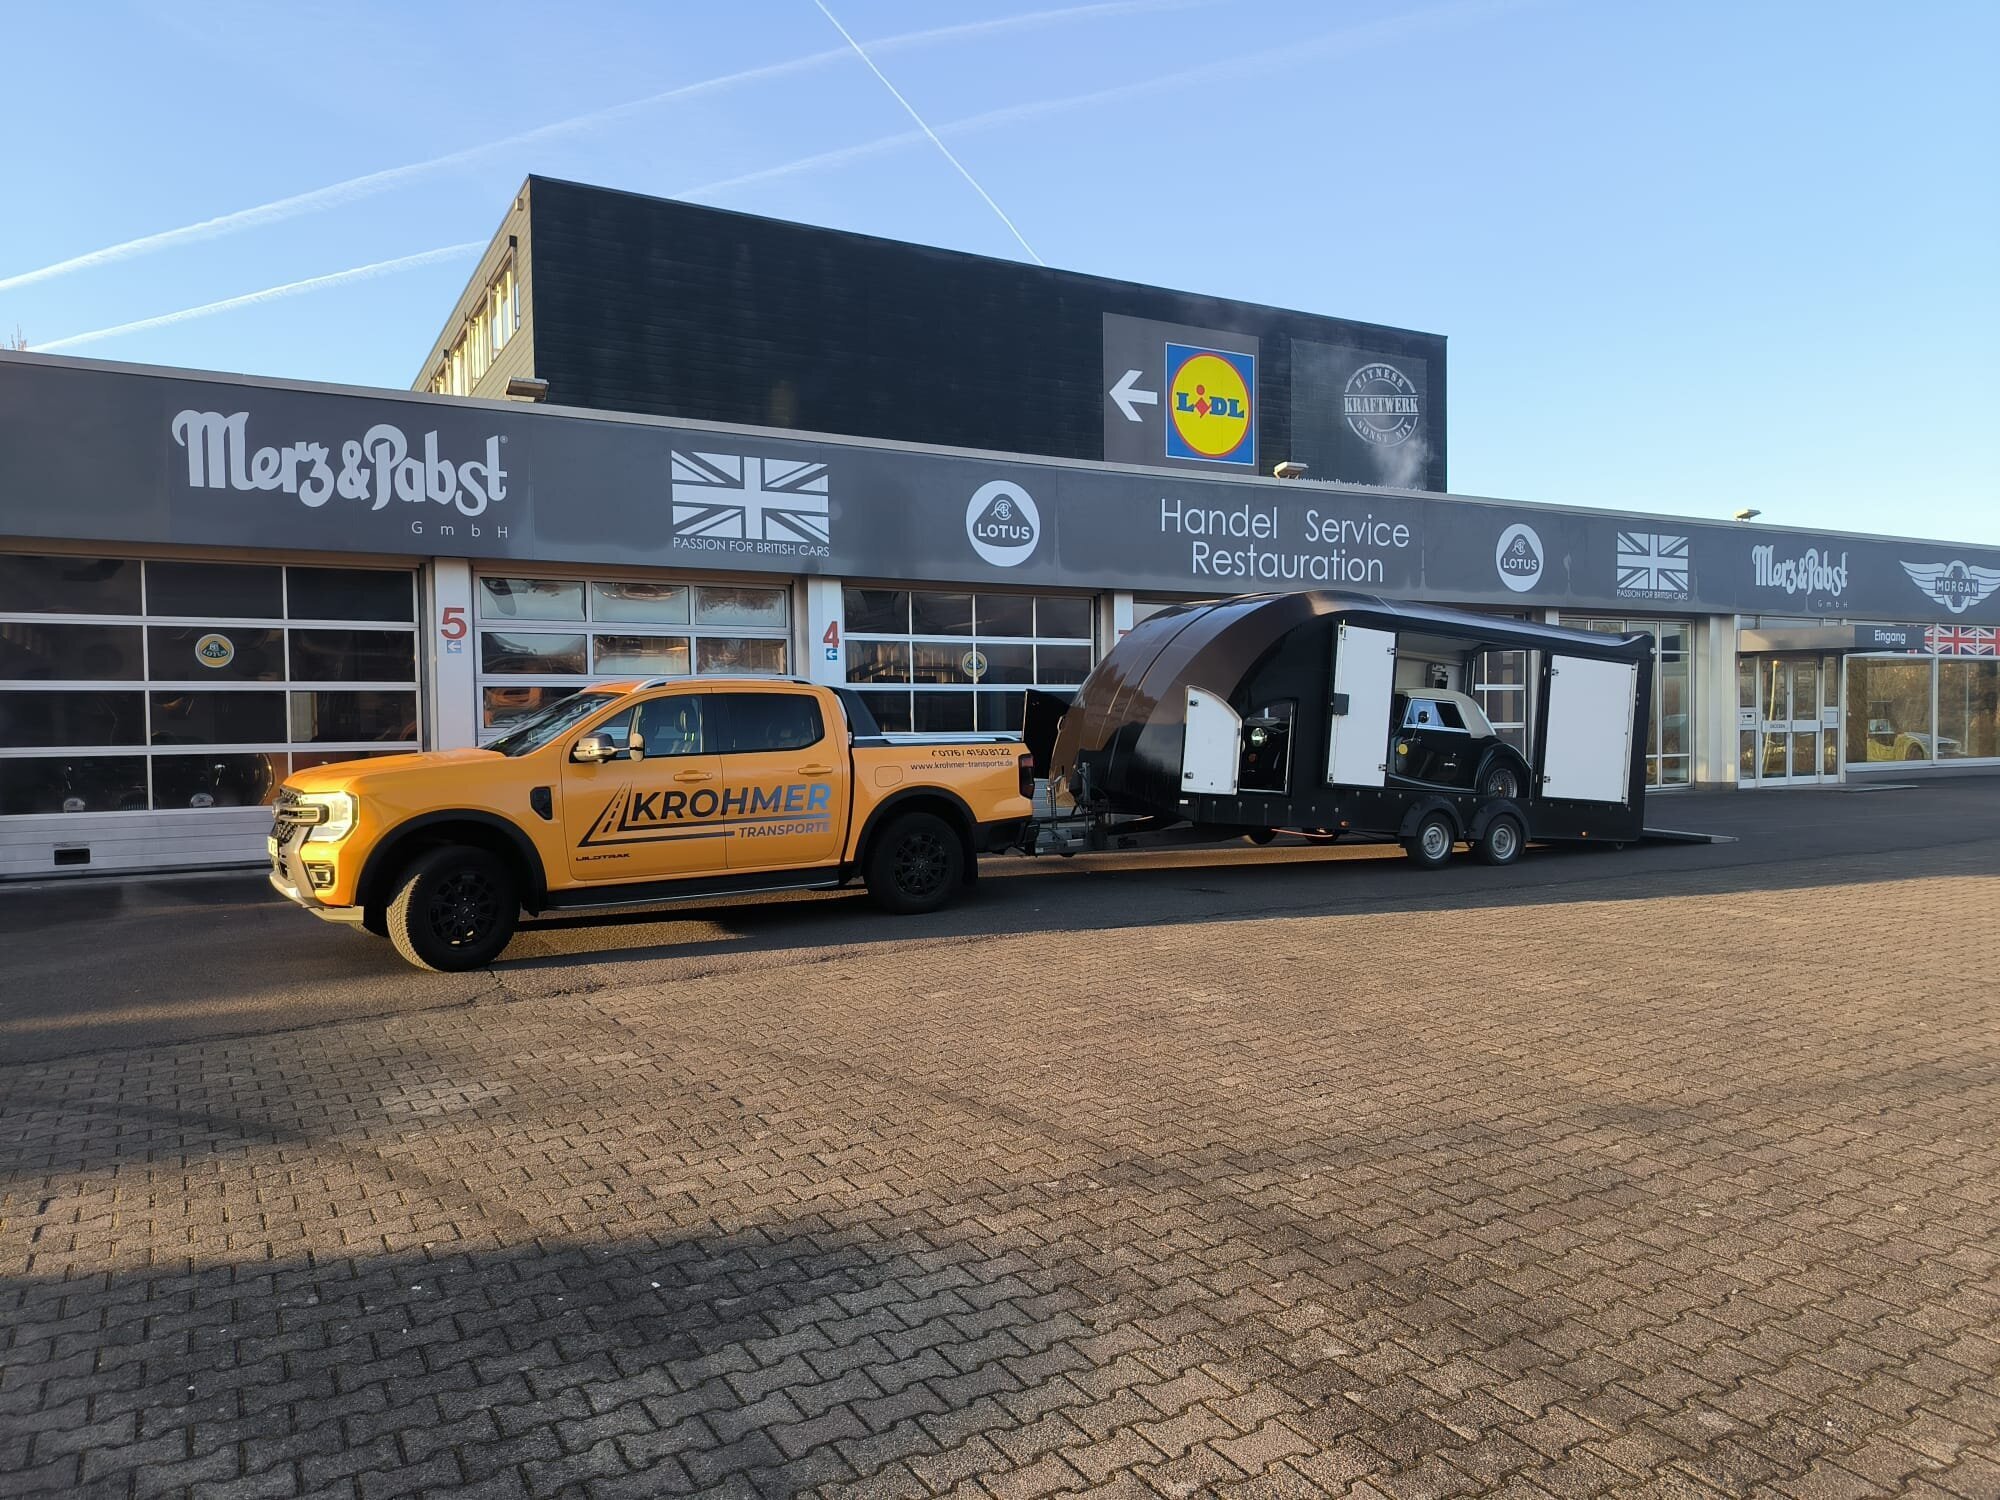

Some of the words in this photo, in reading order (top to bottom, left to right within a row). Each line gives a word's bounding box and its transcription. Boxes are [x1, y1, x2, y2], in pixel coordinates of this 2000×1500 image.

[1356, 368, 1404, 388] FITNESS
[1344, 397, 1418, 413] KRAFTWERK
[977, 523, 1030, 540] LOTUS
[1161, 498, 1277, 539] Handel
[1304, 509, 1410, 548] Service
[673, 536, 726, 551] PASSION
[729, 540, 753, 552] FOR
[757, 542, 796, 556] BRITISH
[799, 544, 830, 557] CARS
[1192, 541, 1383, 583] Restauration
[1503, 557, 1538, 570] LOTUS
[1617, 589, 1640, 598] PASSION
[1642, 590, 1653, 599] FOR
[1654, 591, 1672, 600] BRITISH
[1673, 592, 1688, 600] CARS
[1936, 579, 1978, 593] MORGAN
[441, 607, 467, 639] 5
[823, 620, 840, 648] 4
[1874, 629, 1906, 645] Eingang
[203, 649, 228, 657] LOTUS
[939, 749, 961, 757] 0176
[632, 784, 832, 822] KROHMER
[738, 821, 831, 839] TRANSPORTE
